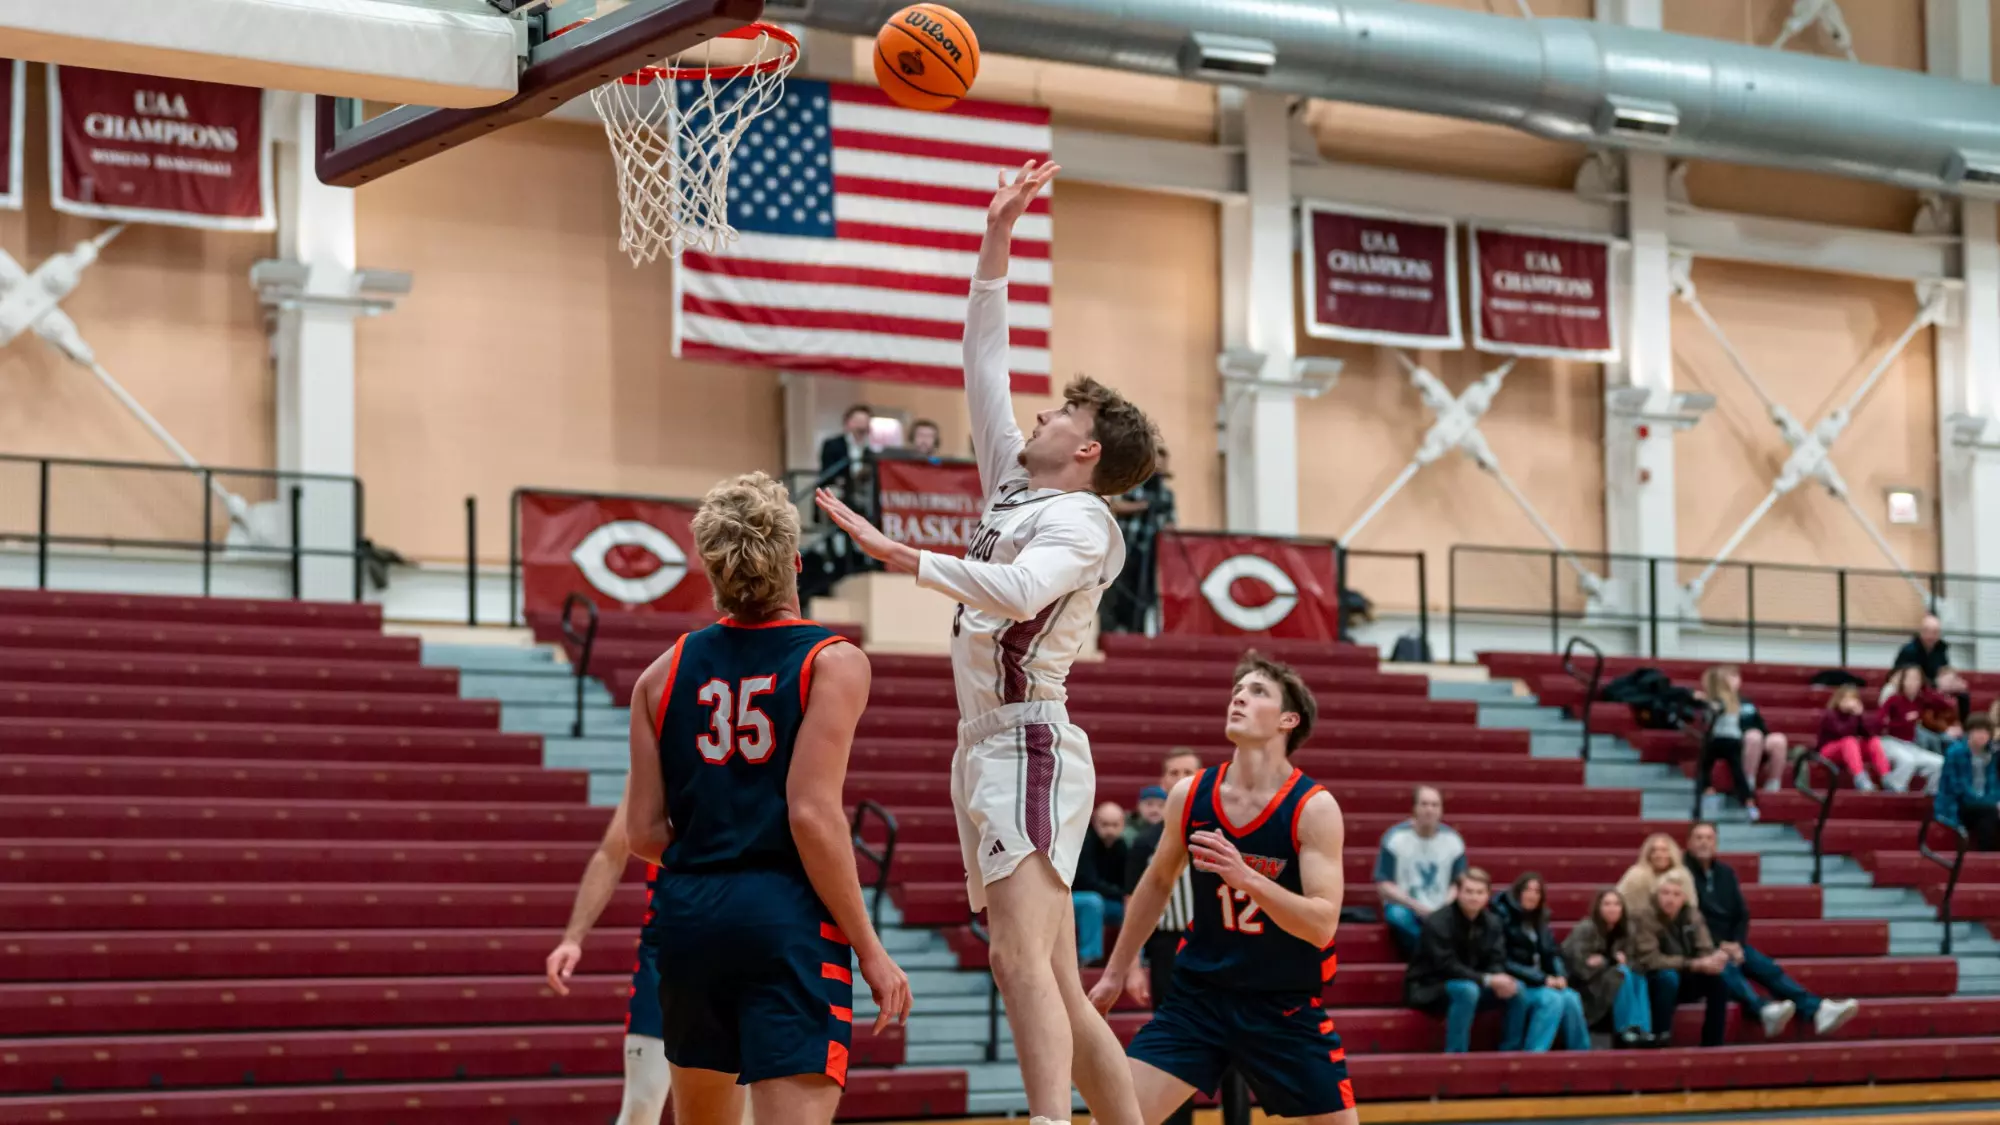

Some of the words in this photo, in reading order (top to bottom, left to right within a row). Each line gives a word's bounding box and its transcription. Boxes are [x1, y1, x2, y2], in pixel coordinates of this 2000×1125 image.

[905, 11, 962, 63] Wilson
[135, 90, 188, 118] UAA
[85, 113, 238, 152] CHAMPIONS
[697, 673, 777, 765] 35
[1216, 883, 1264, 935] 12
